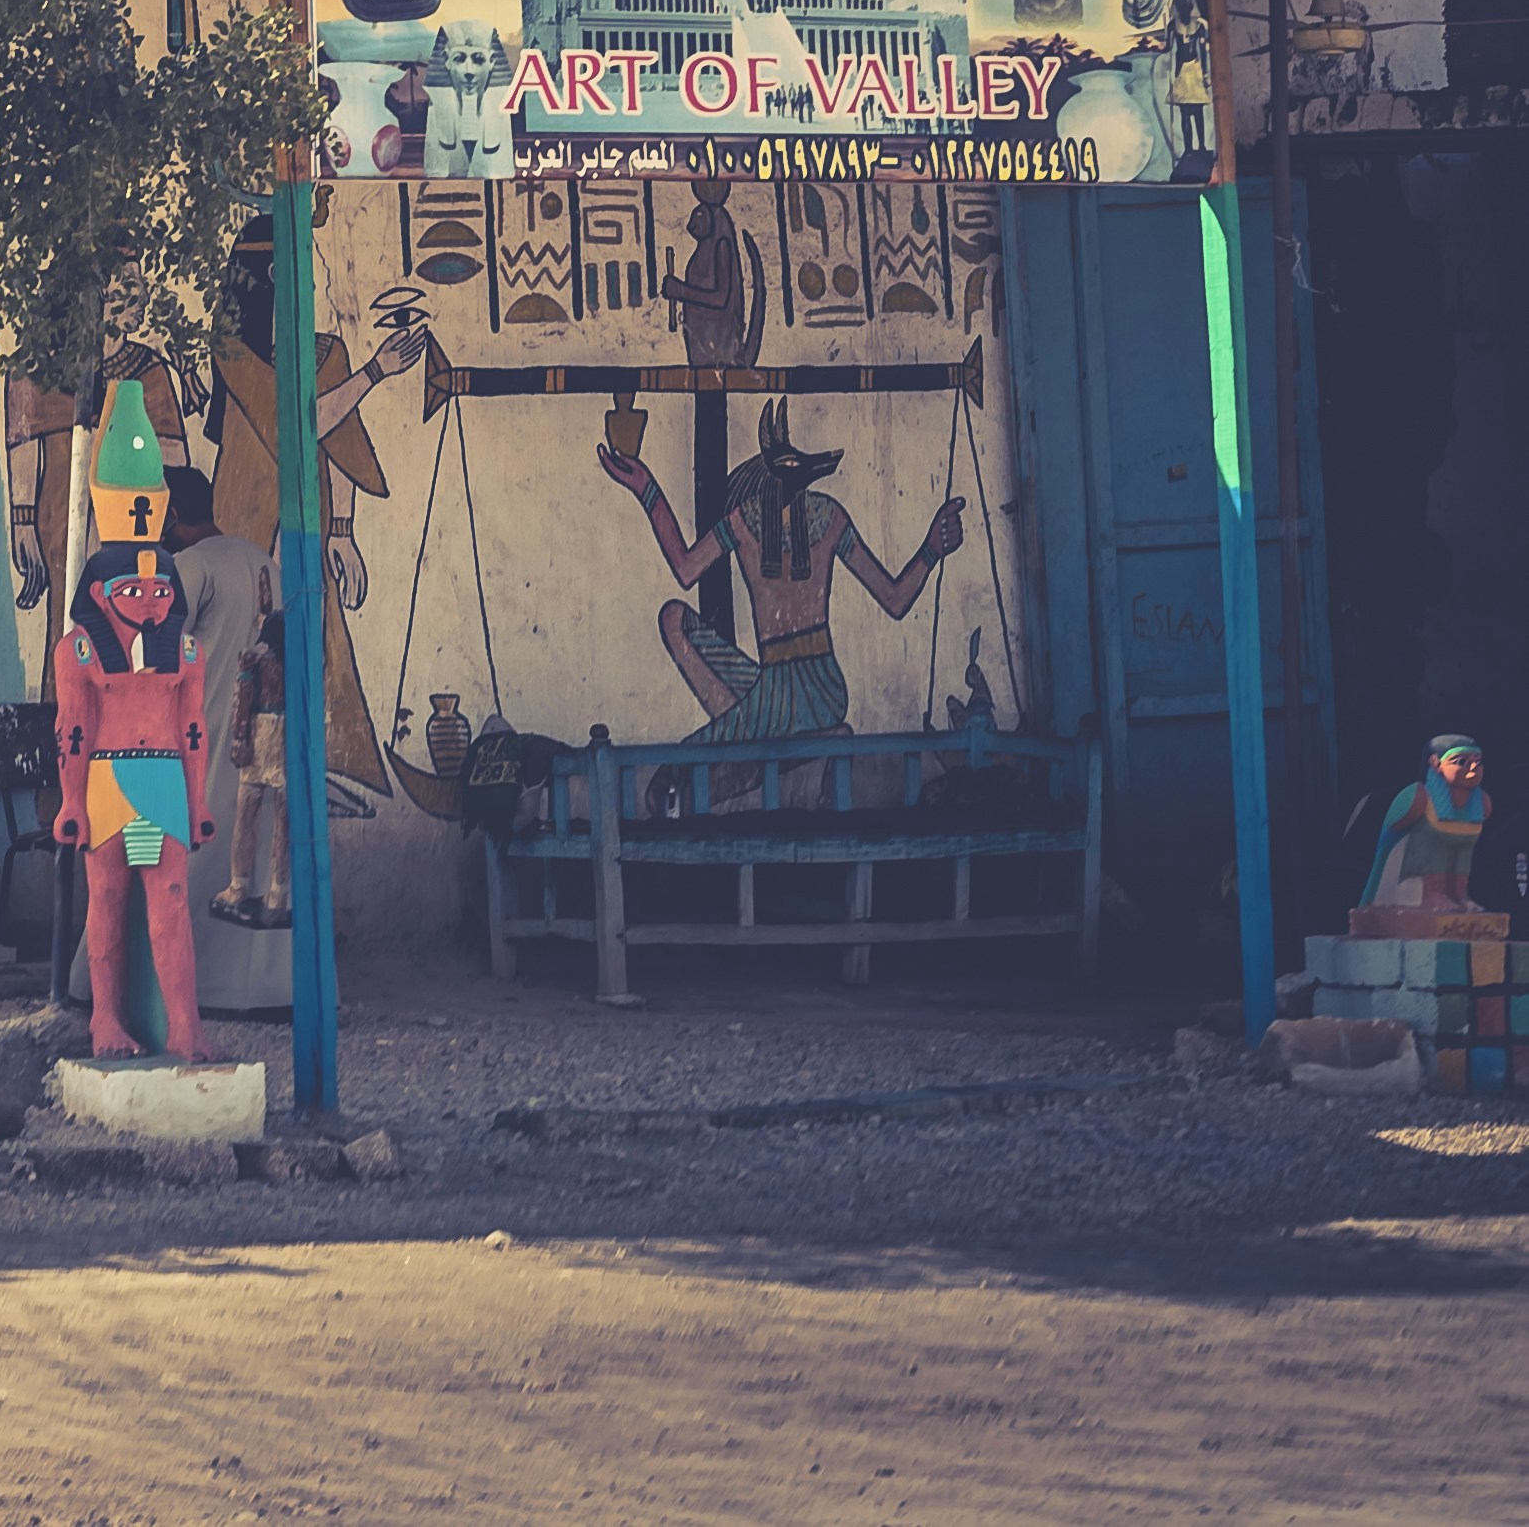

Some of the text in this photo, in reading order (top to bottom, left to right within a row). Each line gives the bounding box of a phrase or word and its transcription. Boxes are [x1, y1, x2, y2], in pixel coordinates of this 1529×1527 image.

[501, 48, 1063, 122] ART OF VALLEY
[575, 139, 625, 180] جابر
[628, 139, 675, 179] المعلم
